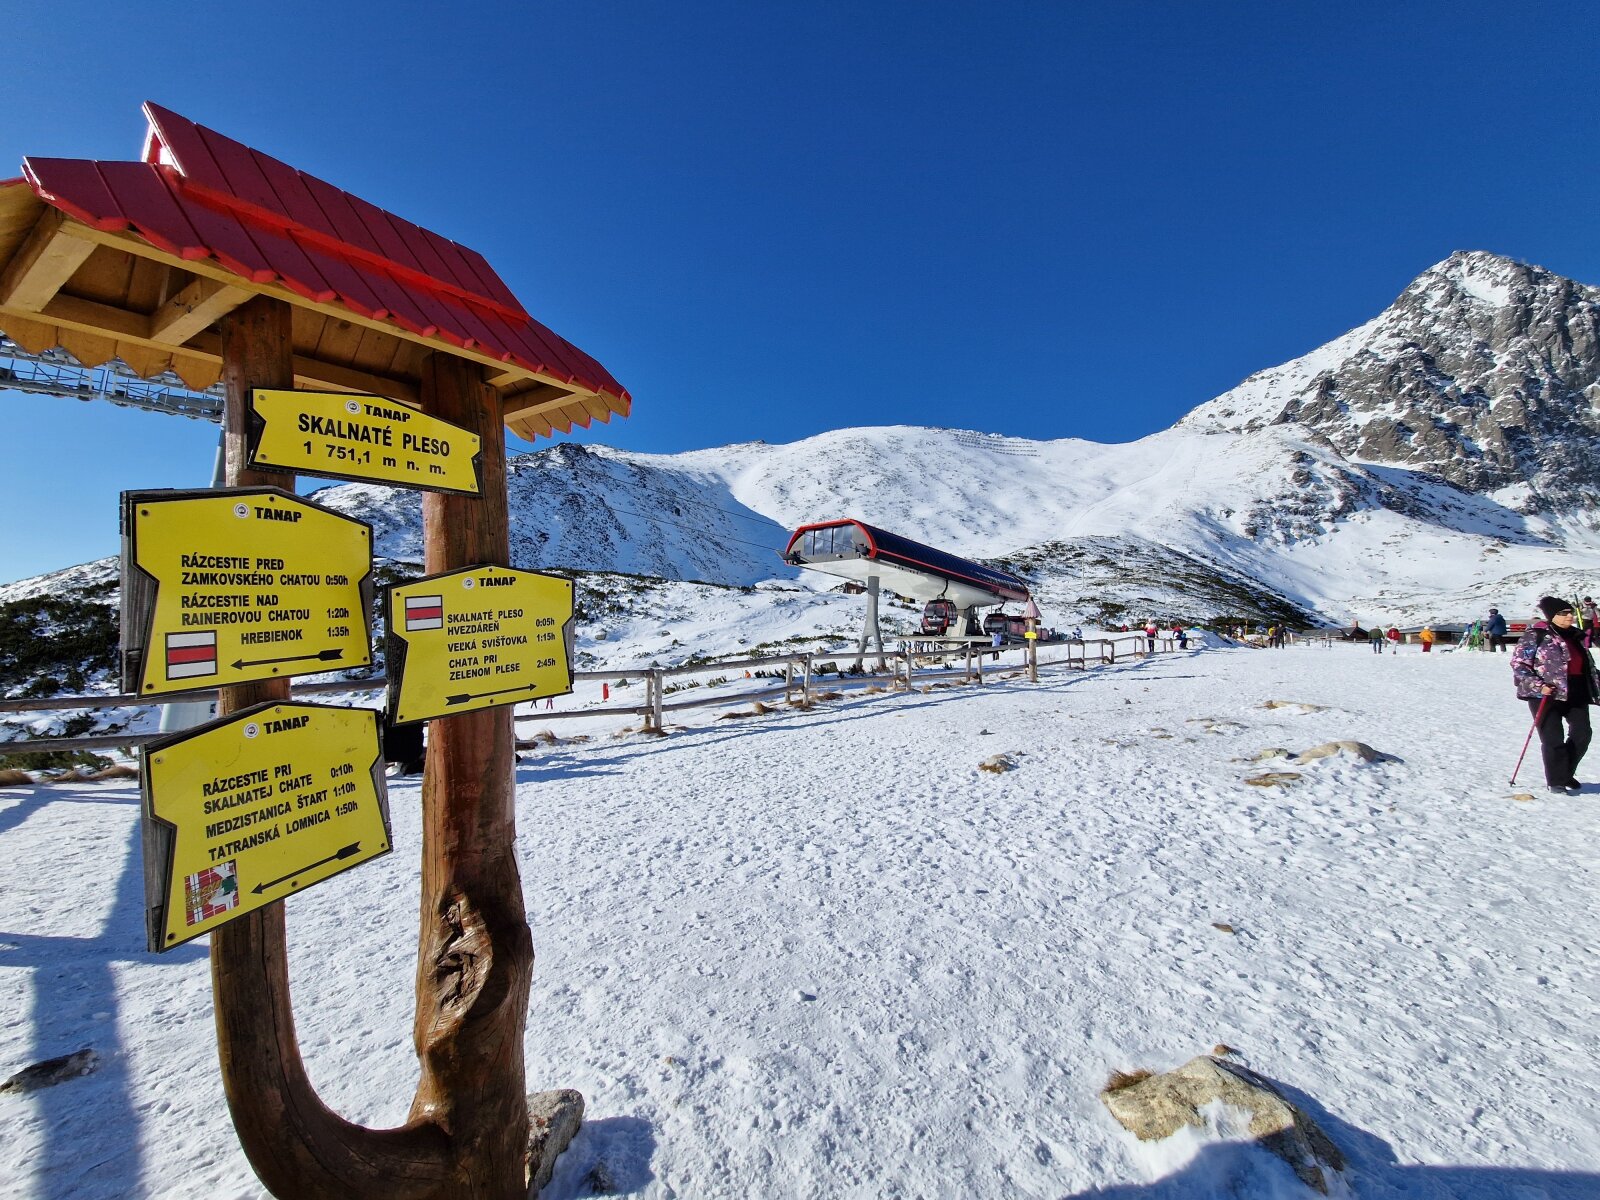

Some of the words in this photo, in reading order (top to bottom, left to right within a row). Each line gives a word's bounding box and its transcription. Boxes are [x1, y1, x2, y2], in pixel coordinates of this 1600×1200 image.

[364, 404, 410, 422] TANAP
[298, 413, 392, 446] SKALNATÉ
[402, 433, 450, 456] PLESO
[304, 441, 311, 454] 1
[326, 444, 370, 464] 751,1
[383, 456, 396, 467] m
[407, 460, 419, 471] n.
[430, 464, 445, 475] m.
[254, 507, 301, 522] TANAP
[182, 552, 249, 570] RÁZCESTIE
[257, 558, 284, 570] PRED
[182, 571, 273, 585] ZAMKOVSKÉHO
[280, 575, 320, 585] CHATOU
[326, 575, 348, 586] 0:50h
[479, 577, 516, 587] TANAP
[182, 593, 249, 608] RÁZCESTIE
[257, 595, 278, 606] NAD
[182, 611, 261, 626] RAINEROVOU
[268, 609, 310, 621] CHATOU
[327, 608, 349, 618] 1:20h
[448, 610, 493, 623] SKALNATÉ
[498, 609, 523, 619] PLESO
[241, 629, 302, 644] HREBIENOK
[327, 627, 349, 637] 1:35h
[448, 621, 499, 635] HVEZDÁREŇ
[536, 618, 554, 628] 0:05h
[482, 636, 527, 648] SVIŠŤOVKA
[537, 633, 555, 642] 1:15h
[449, 657, 478, 668] CHATA
[484, 655, 497, 664] PRI
[450, 667, 491, 680] ZELENOM
[496, 663, 520, 674] PLESE
[537, 658, 555, 668] 2:45h
[264, 716, 309, 734] TANAP
[203, 769, 268, 796] RÁZCESTIE
[274, 764, 292, 778] PRI
[204, 785, 272, 815] SKALNATEJ
[279, 774, 312, 792] CHATE
[331, 763, 353, 778] 0:10h
[206, 802, 292, 838] MEDZISTANICA
[297, 790, 327, 809] ŠTART
[333, 782, 355, 797] 1:10h
[208, 824, 280, 861] TATRANSKÁ
[286, 812, 330, 834] LOMNICA
[335, 801, 358, 817] 1:50h
